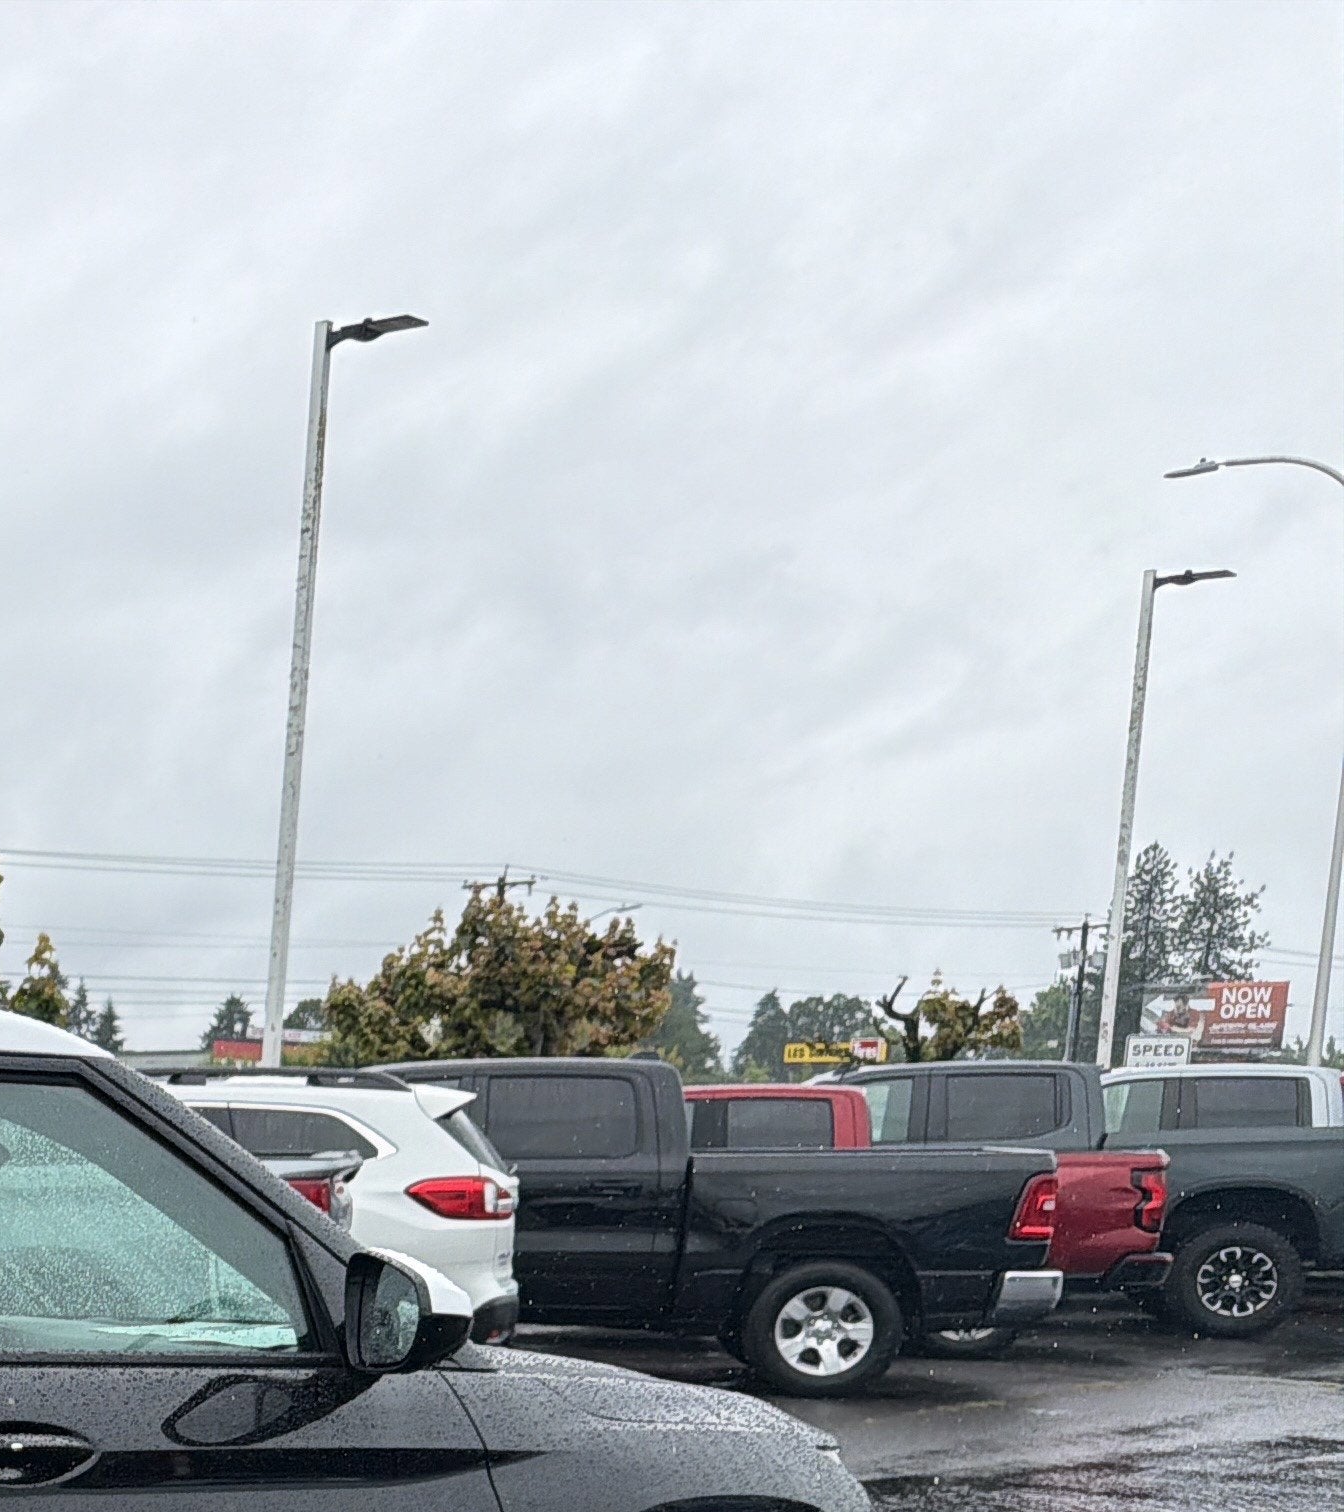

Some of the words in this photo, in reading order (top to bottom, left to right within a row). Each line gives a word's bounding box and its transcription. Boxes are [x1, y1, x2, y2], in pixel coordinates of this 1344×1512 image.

[1221, 986, 1273, 1004] NOW
[1220, 1003, 1272, 1019] OPEN
[1132, 1044, 1185, 1057] SPEED
